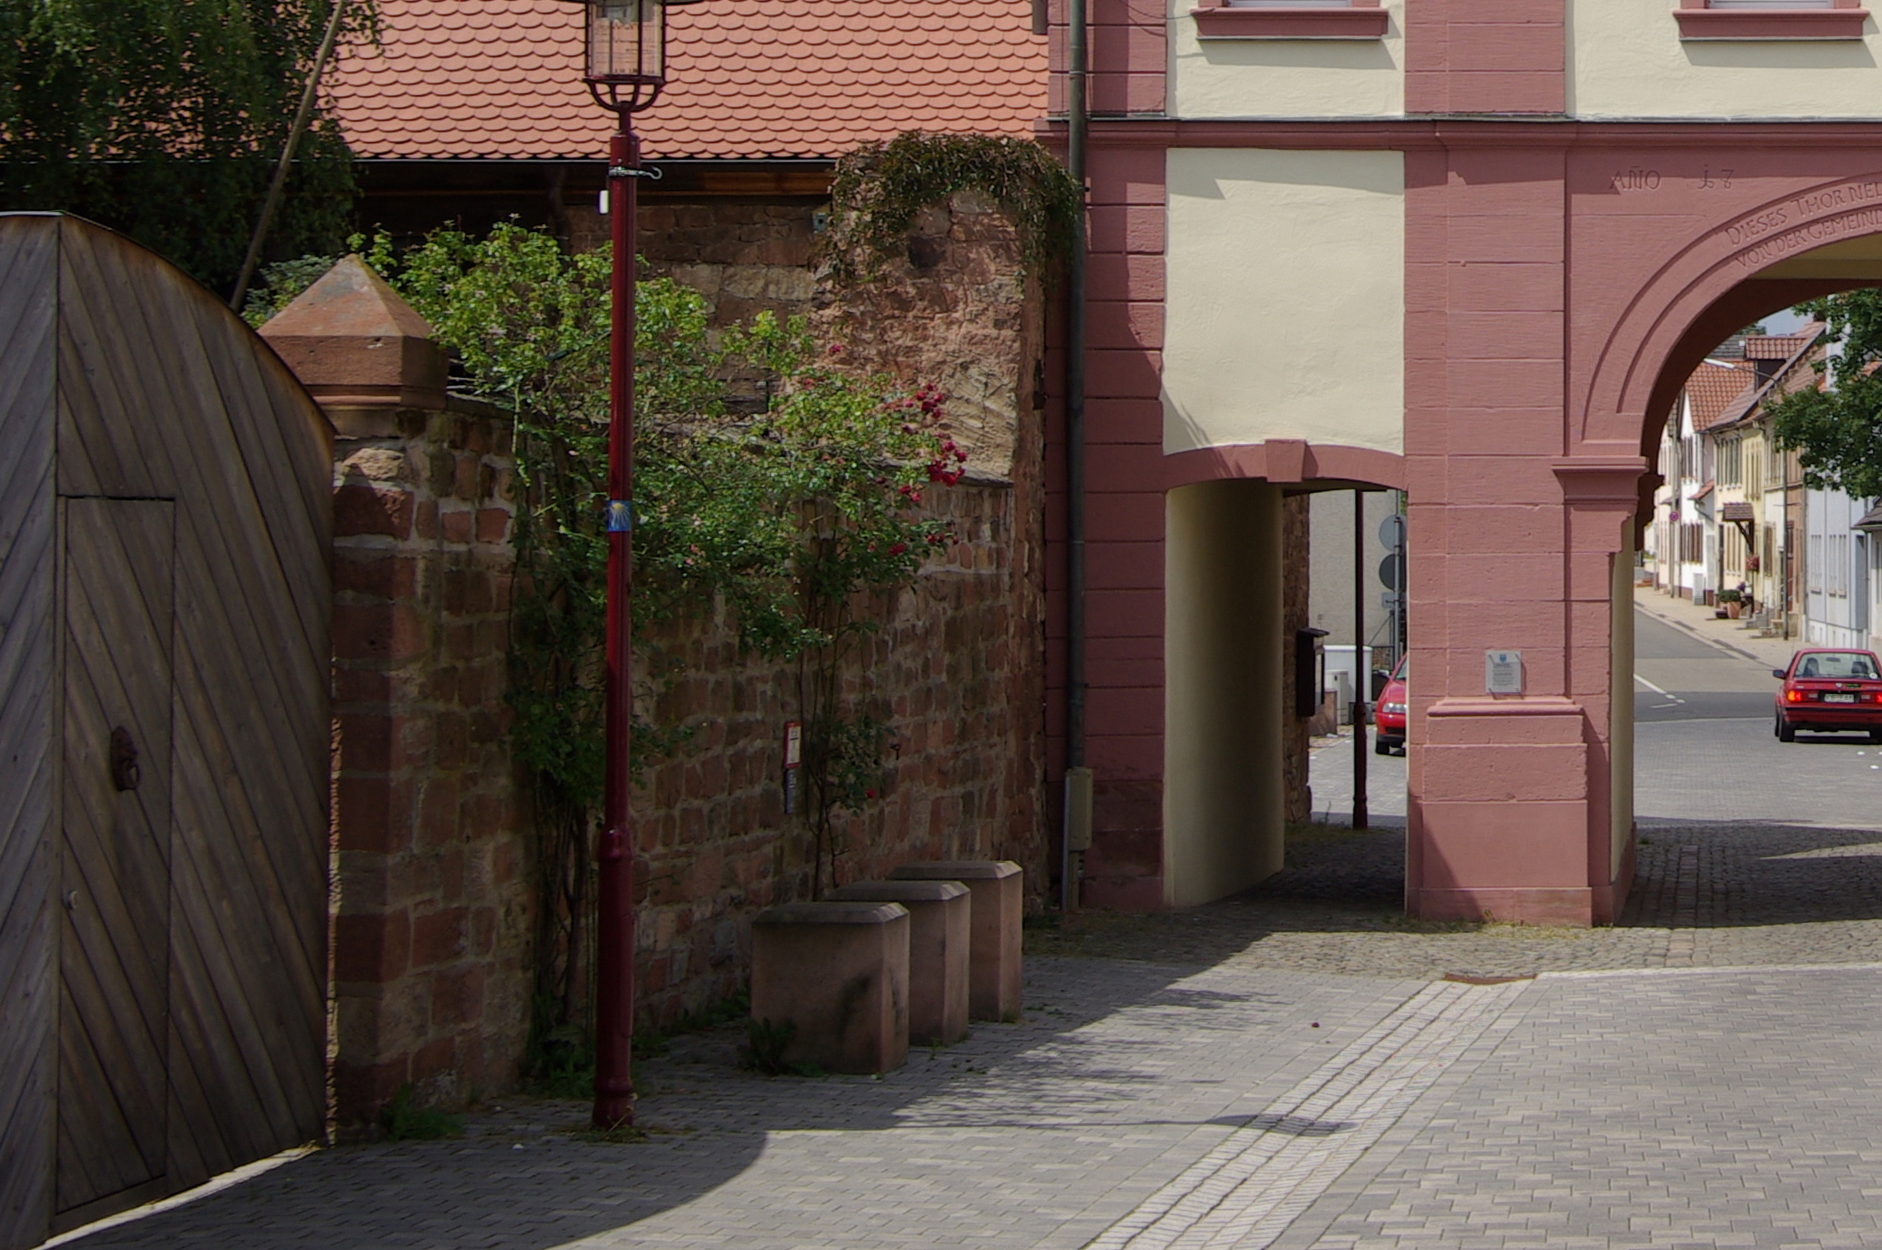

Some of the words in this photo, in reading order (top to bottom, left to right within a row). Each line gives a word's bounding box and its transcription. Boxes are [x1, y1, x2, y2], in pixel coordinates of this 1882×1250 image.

[1724, 207, 1788, 247] DIESES
[1790, 195, 1846, 218] THOR
[1735, 242, 1775, 270] VON
[1775, 229, 1806, 252] DER
